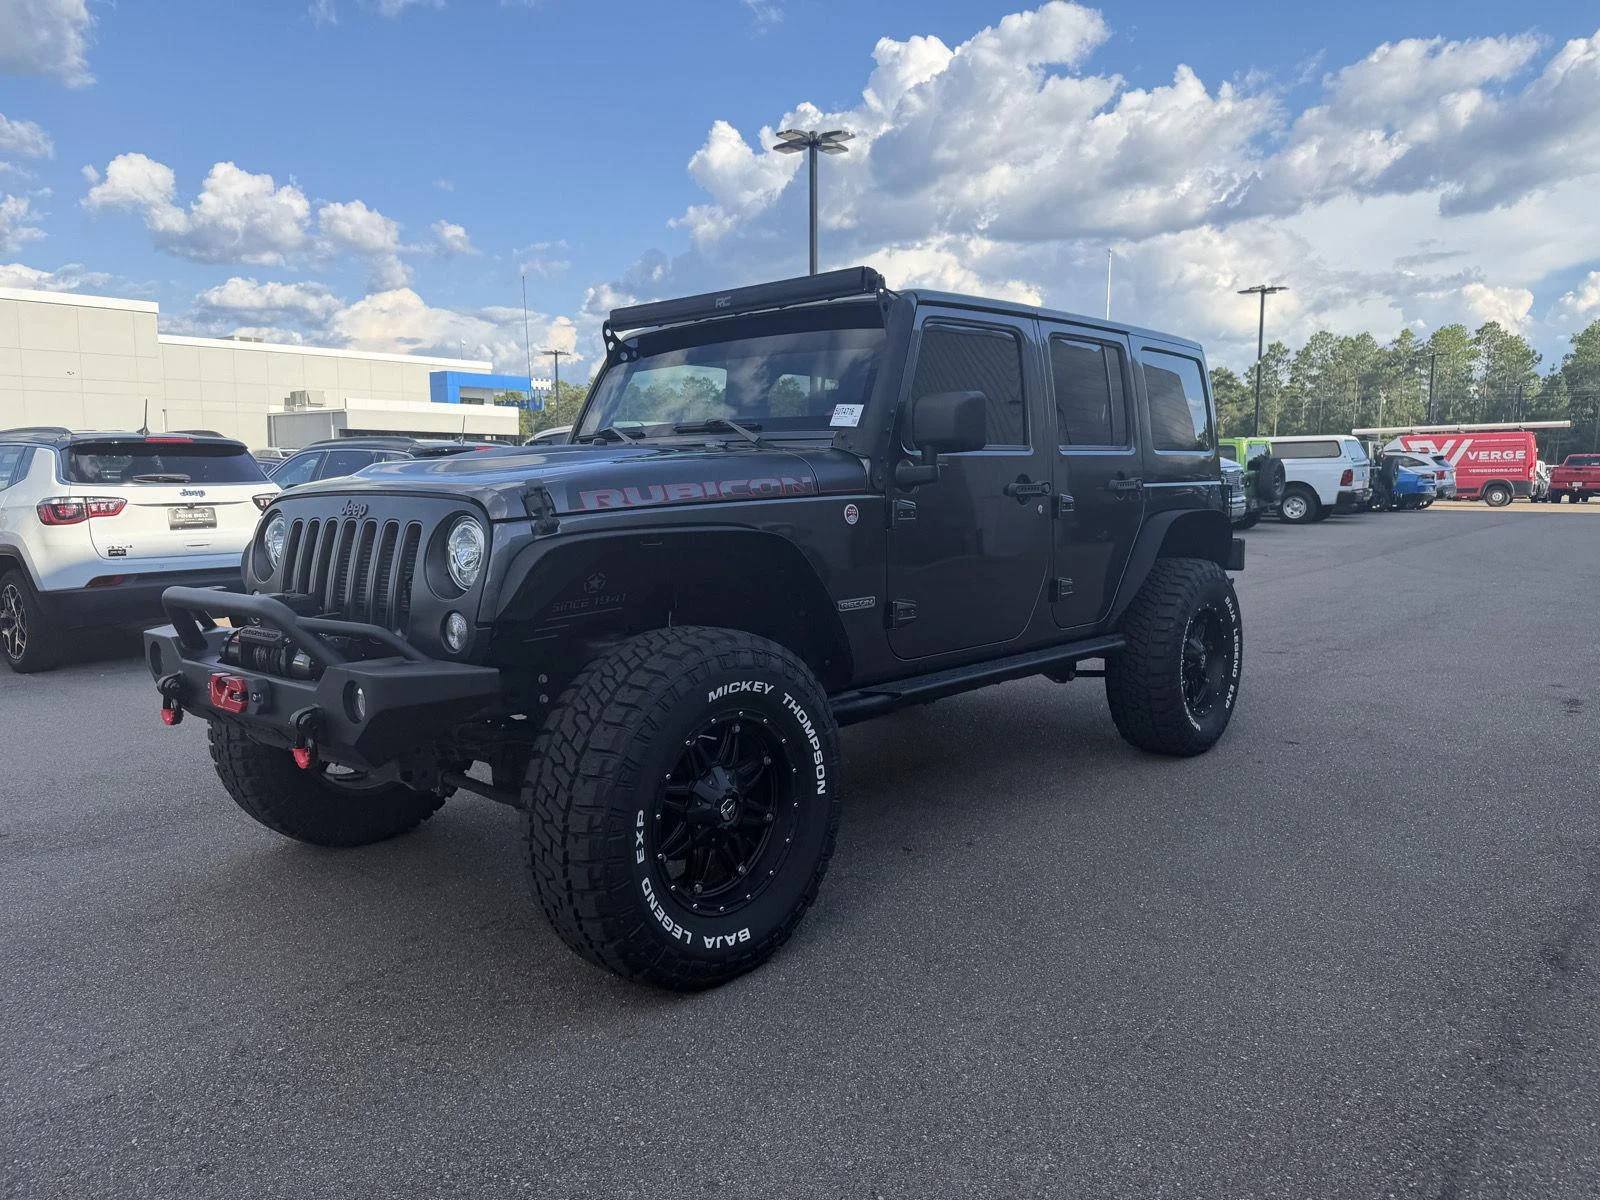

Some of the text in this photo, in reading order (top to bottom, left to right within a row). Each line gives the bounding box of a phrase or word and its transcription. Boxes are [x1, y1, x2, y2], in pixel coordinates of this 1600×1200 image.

[1467, 450, 1526, 460] VERGE
[180, 488, 206, 498] Jeep
[579, 476, 812, 511] RUBICON
[341, 499, 369, 520] Jeep
[552, 600, 589, 613] SINCE
[841, 599, 874, 609] RECON
[1224, 596, 1235, 623] BAJA
[1225, 684, 1235, 709] EXP
[708, 680, 826, 795] MICKEY THOMPSON
[636, 809, 751, 949] BAJA LEGEND EXP
